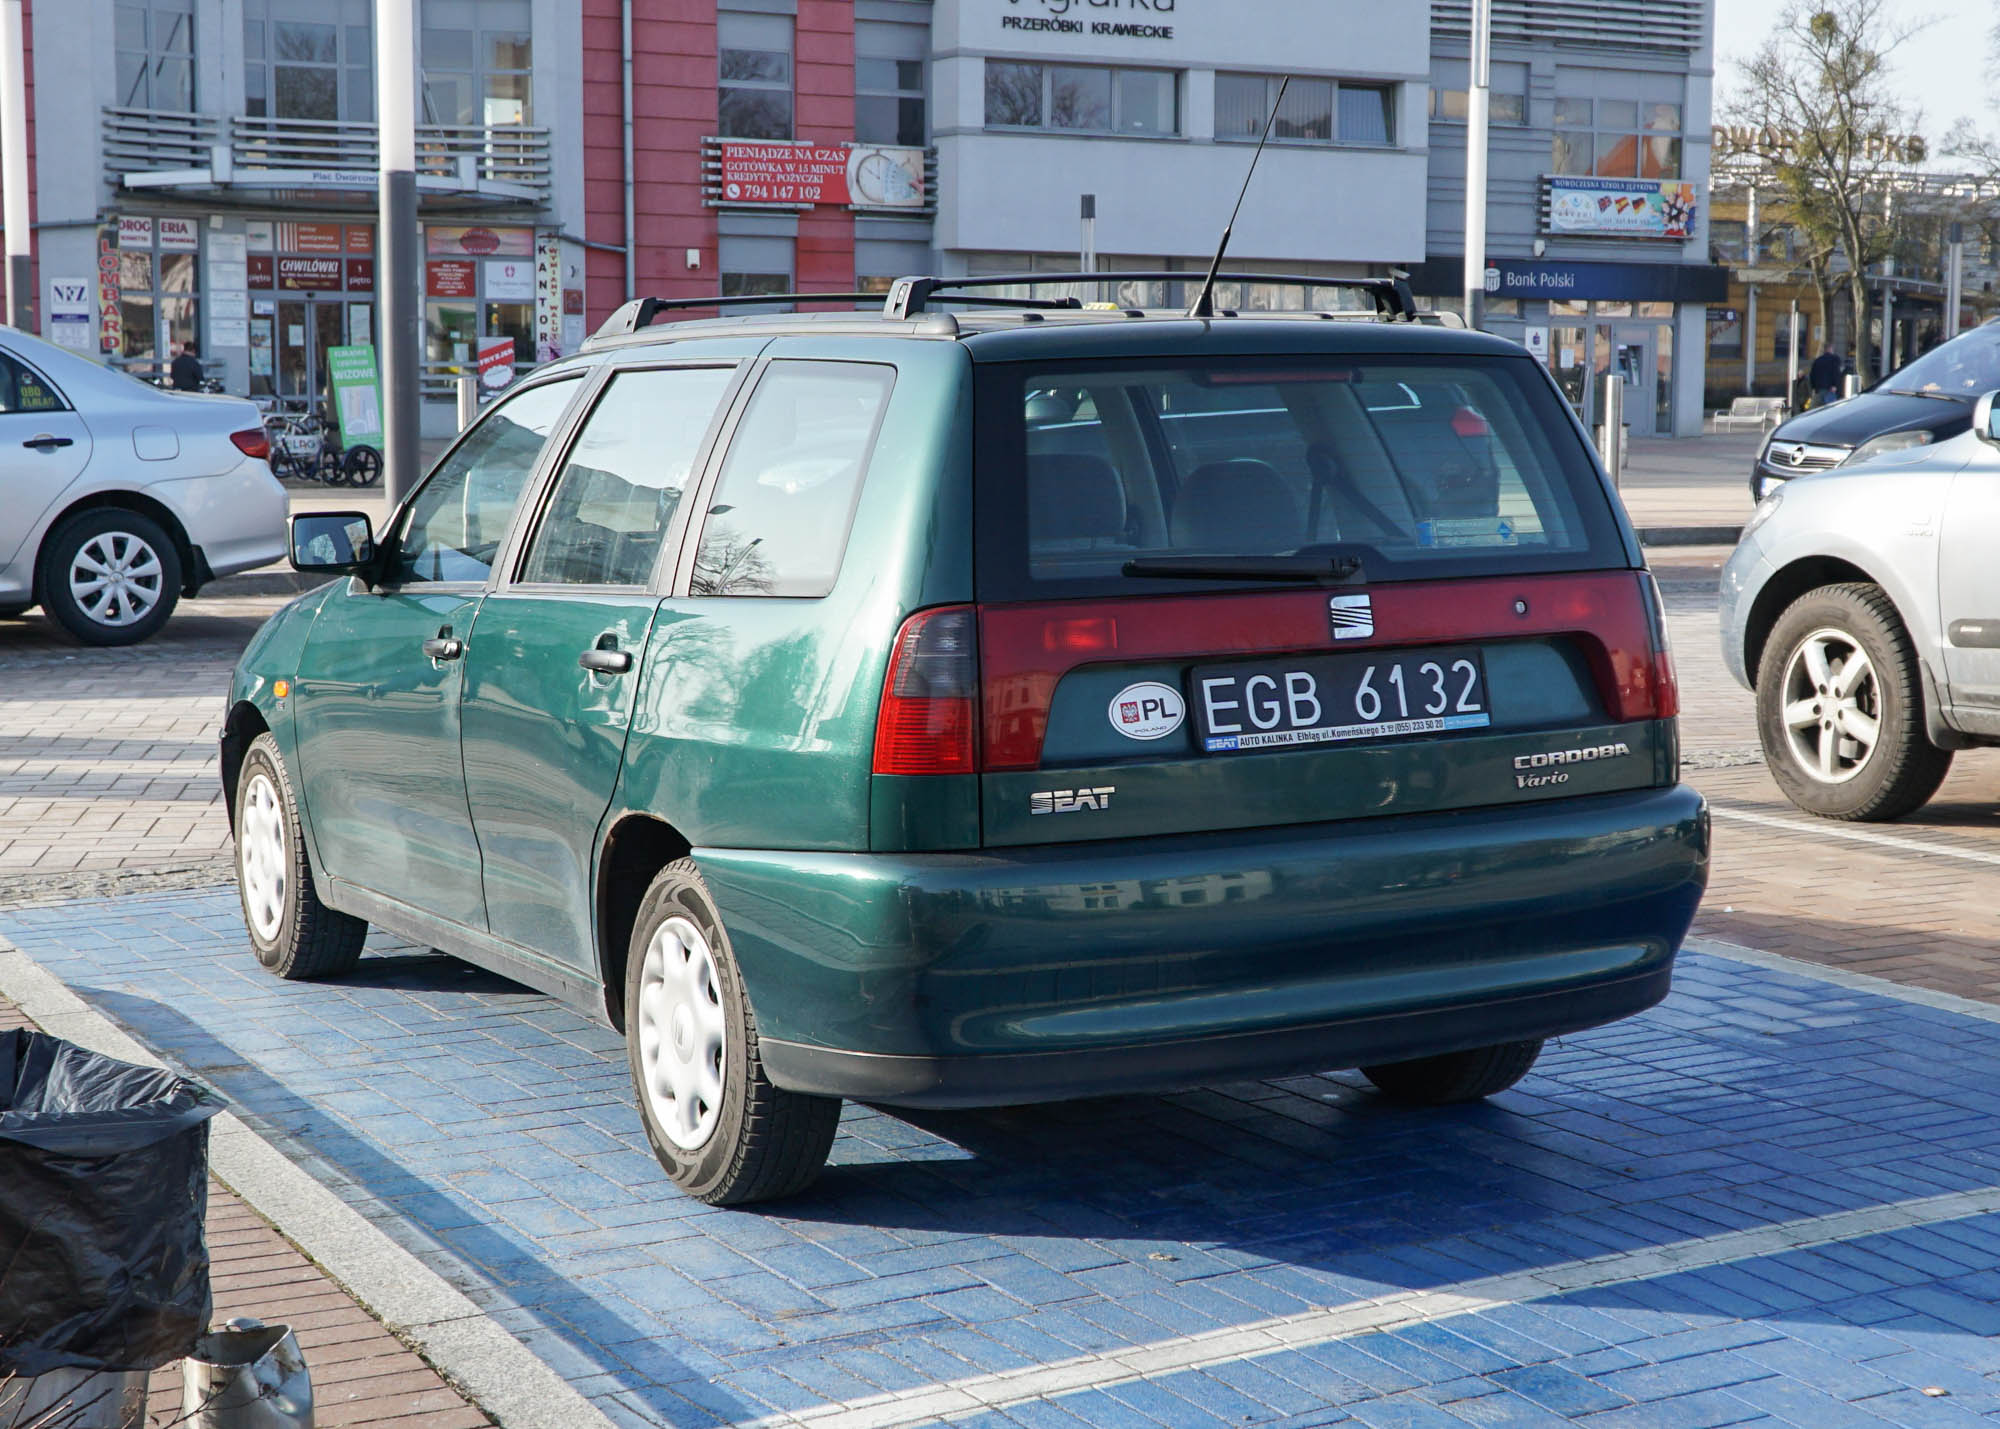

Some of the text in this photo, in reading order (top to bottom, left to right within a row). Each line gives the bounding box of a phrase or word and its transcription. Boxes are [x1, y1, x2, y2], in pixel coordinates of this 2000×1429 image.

[1003, 16, 1174, 39] PRZERÓBKI KRAWIECKIE
[726, 146, 845, 161] PIENIĄDZE NA CZAS
[726, 160, 845, 175] GOTÓWKA W 15 MINUT
[744, 184, 821, 200] 794 147 102
[280, 259, 338, 273] CHWILÓWKI
[1507, 271, 1537, 287] Bank
[1541, 272, 1575, 288] Polski
[100, 240, 120, 350] LOMBARD
[538, 245, 548, 342] KANTOR
[1202, 660, 1481, 734] EGB 6132
[1142, 698, 1177, 720] PL
[1208, 738, 1237, 749] SEAT
[1240, 736, 1260, 747] AUTO
[1262, 734, 1294, 744] KALINKA
[1413, 721, 1425, 731] 233
[1426, 721, 1434, 729] 50
[1435, 719, 1444, 728] 20
[1514, 743, 1630, 769] CORDOBA
[1516, 771, 1569, 788] Vario
[1029, 785, 1115, 816] SEAT
